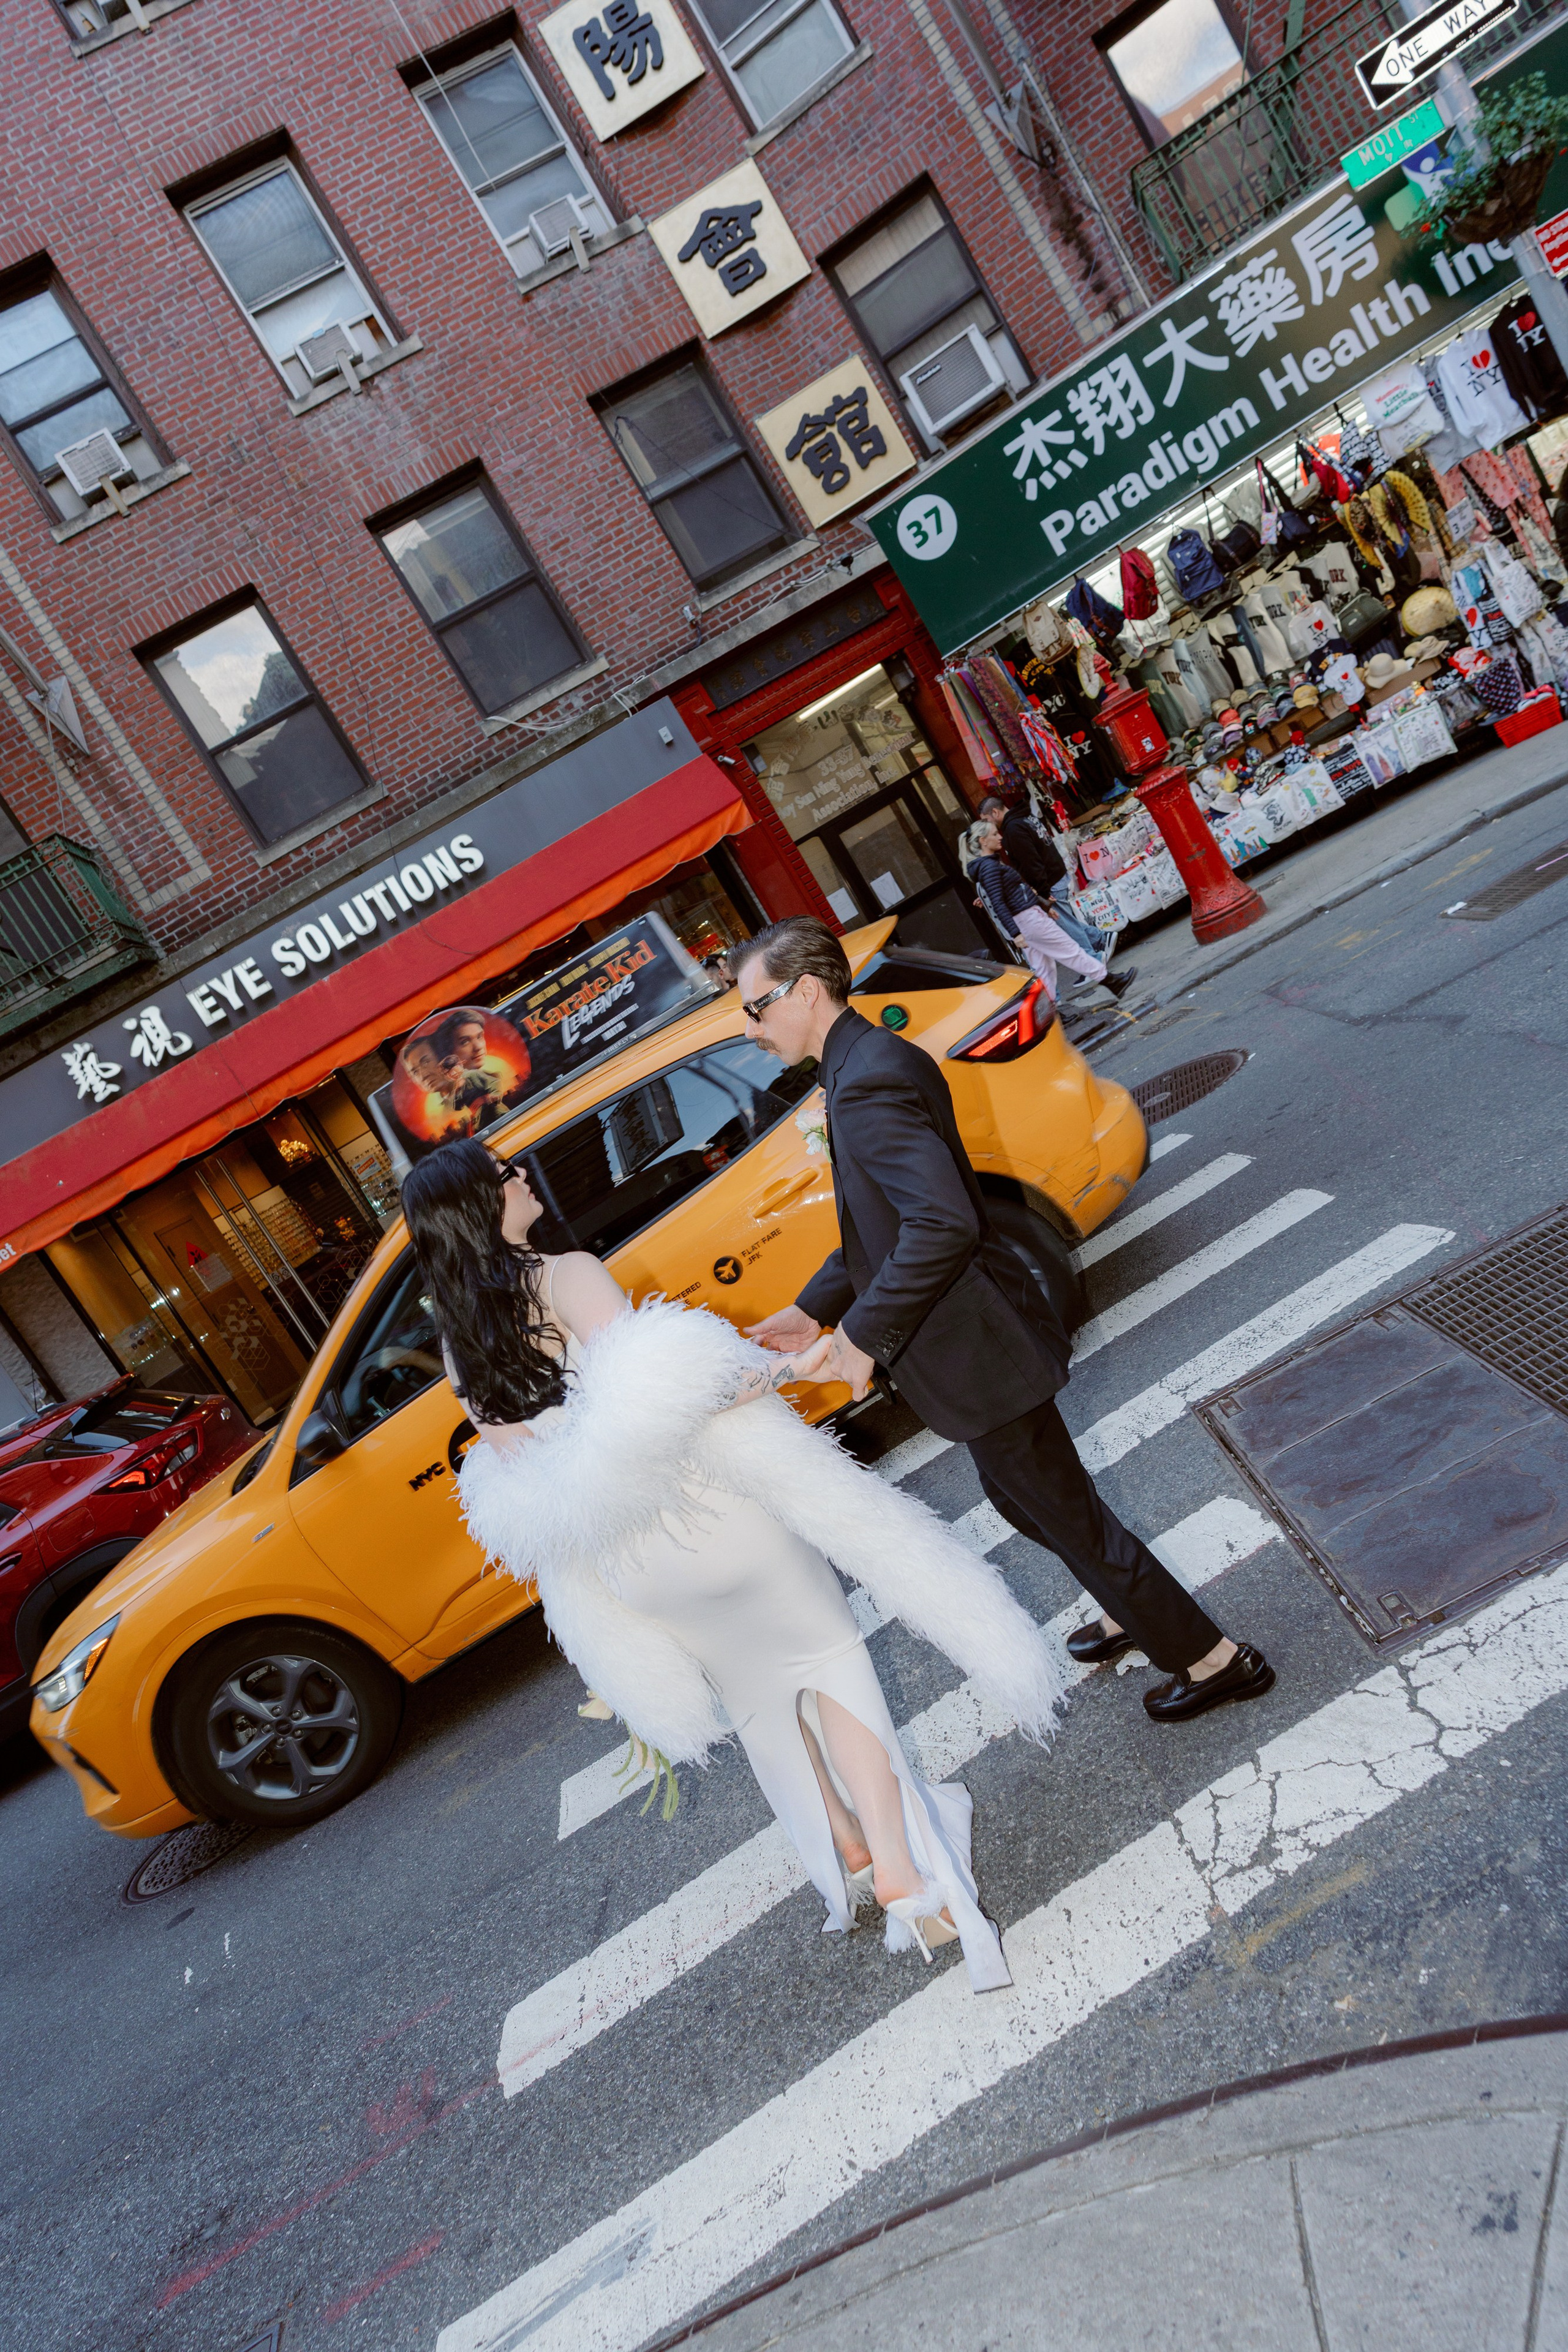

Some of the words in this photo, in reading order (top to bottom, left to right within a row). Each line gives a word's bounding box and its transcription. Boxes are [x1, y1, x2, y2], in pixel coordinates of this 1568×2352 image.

[1386, 37, 1428, 77] ONE
[1443, 0, 1490, 34] WAY
[1357, 123, 1404, 166] MOTT
[1003, 194, 1380, 501] 杰翔大藥房
[1040, 395, 1259, 556] Paradigm
[1259, 281, 1431, 411] Health
[906, 505, 946, 549] 37
[1090, 895, 1105, 908] NEW
[1091, 903, 1109, 916] YORK
[187, 956, 273, 1028] EYE
[271, 834, 485, 978] SOLUTIONS
[521, 976, 612, 1040] Karate
[601, 939, 657, 985] Kid
[741, 1242, 761, 1257] FLAT
[761, 1227, 783, 1244] FARE
[746, 1251, 763, 1265] JFK
[409, 1461, 447, 1491] NYC
